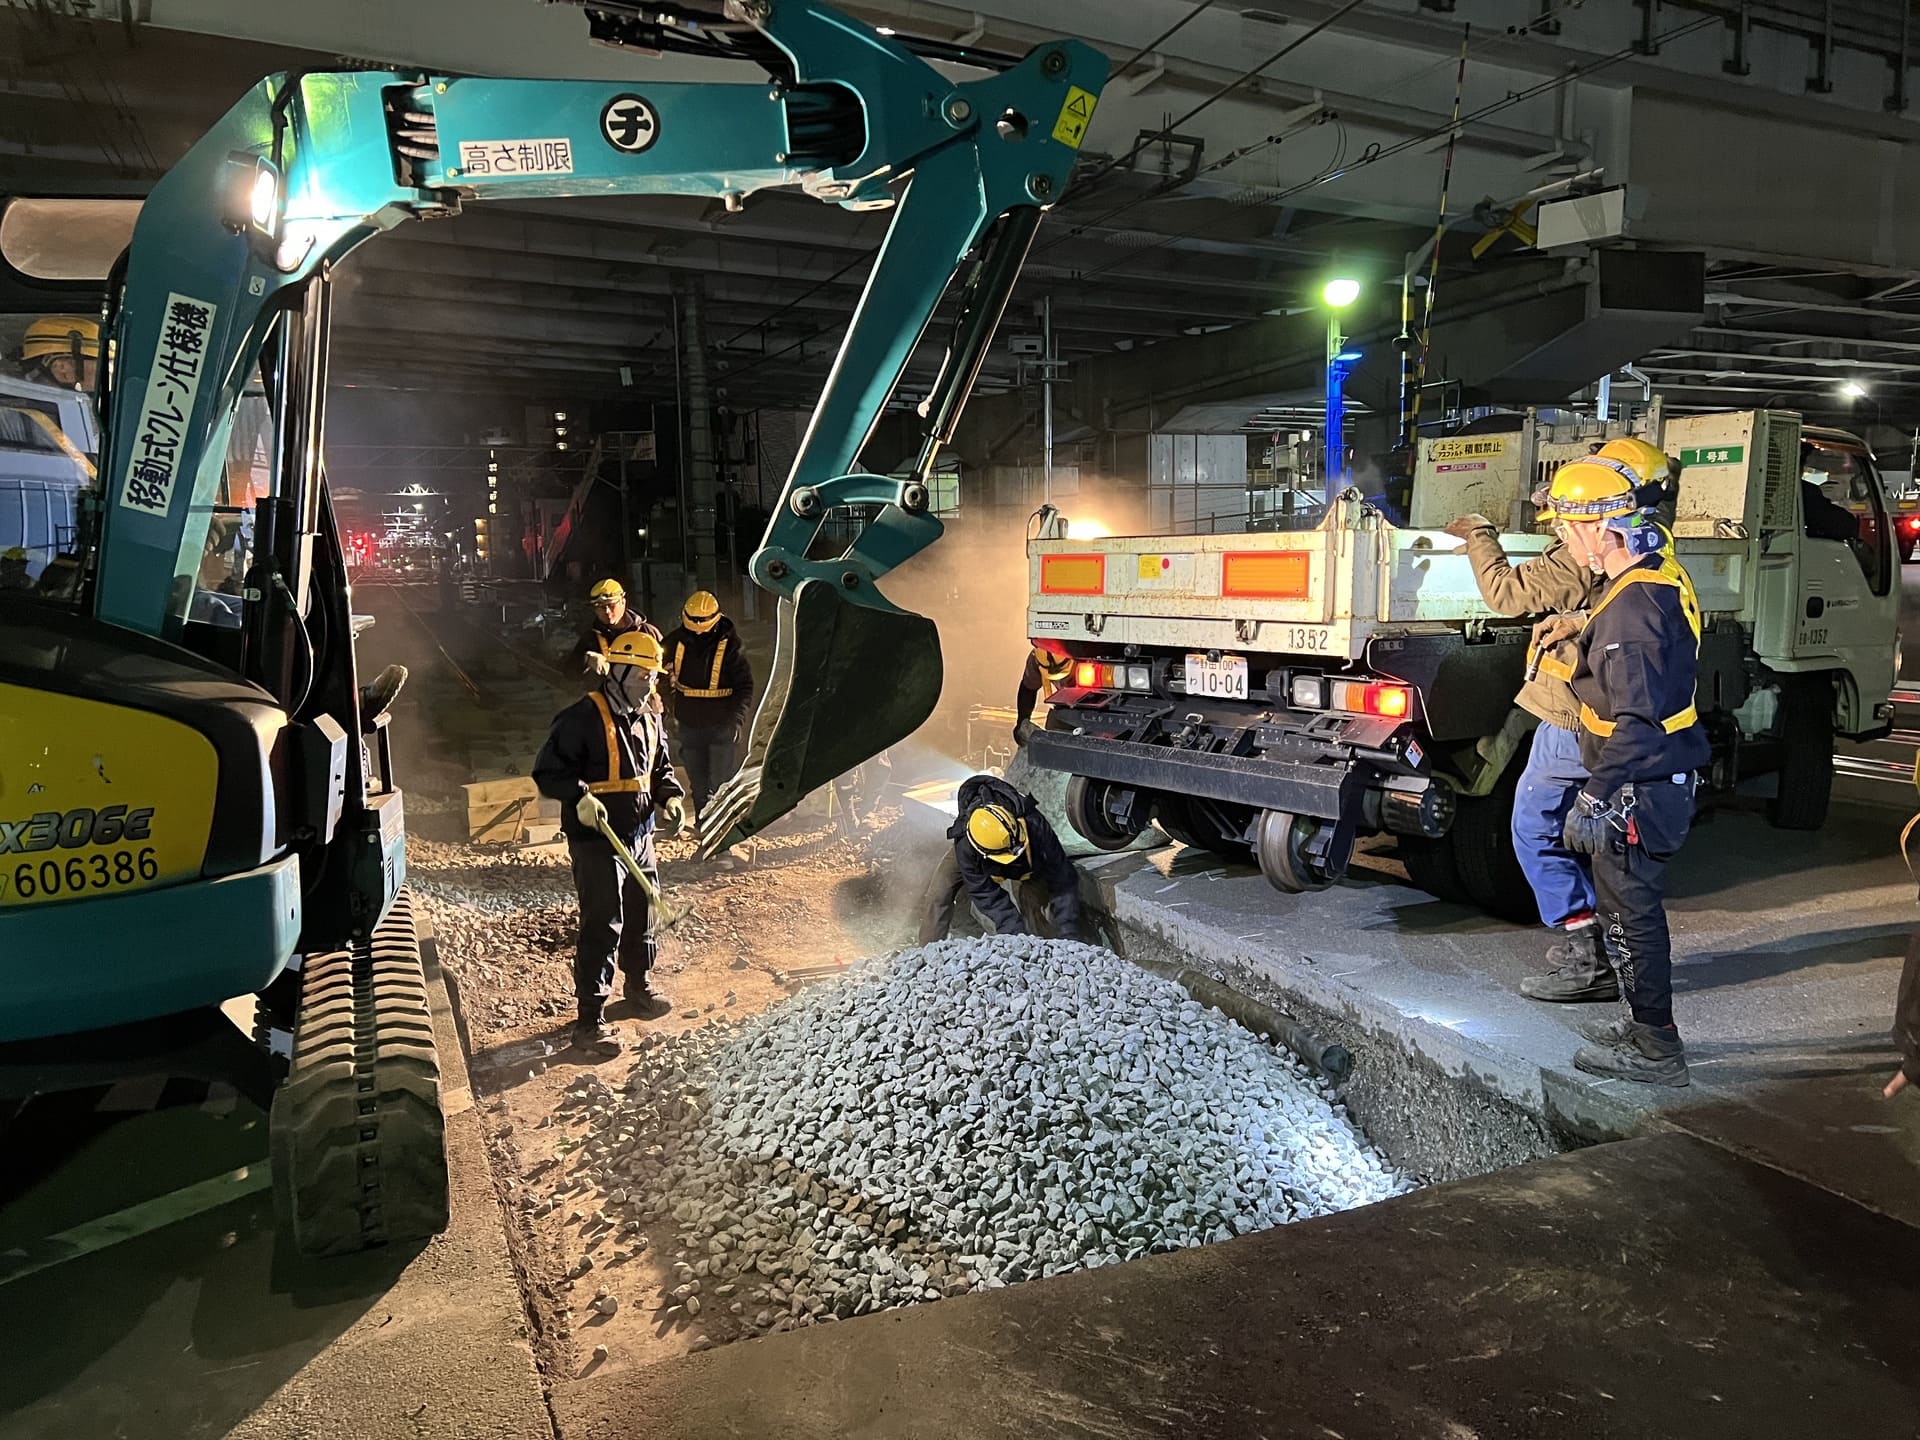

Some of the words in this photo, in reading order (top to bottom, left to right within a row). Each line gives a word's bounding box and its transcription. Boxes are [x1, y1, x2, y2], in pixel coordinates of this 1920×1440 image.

[463, 142, 571, 173] 高さ制限
[127, 302, 209, 509] 移動式クレーン仕様機
[1288, 628, 1328, 650] 1352
[1202, 671, 1243, 695] 10-04
[15, 847, 158, 898] 606386
